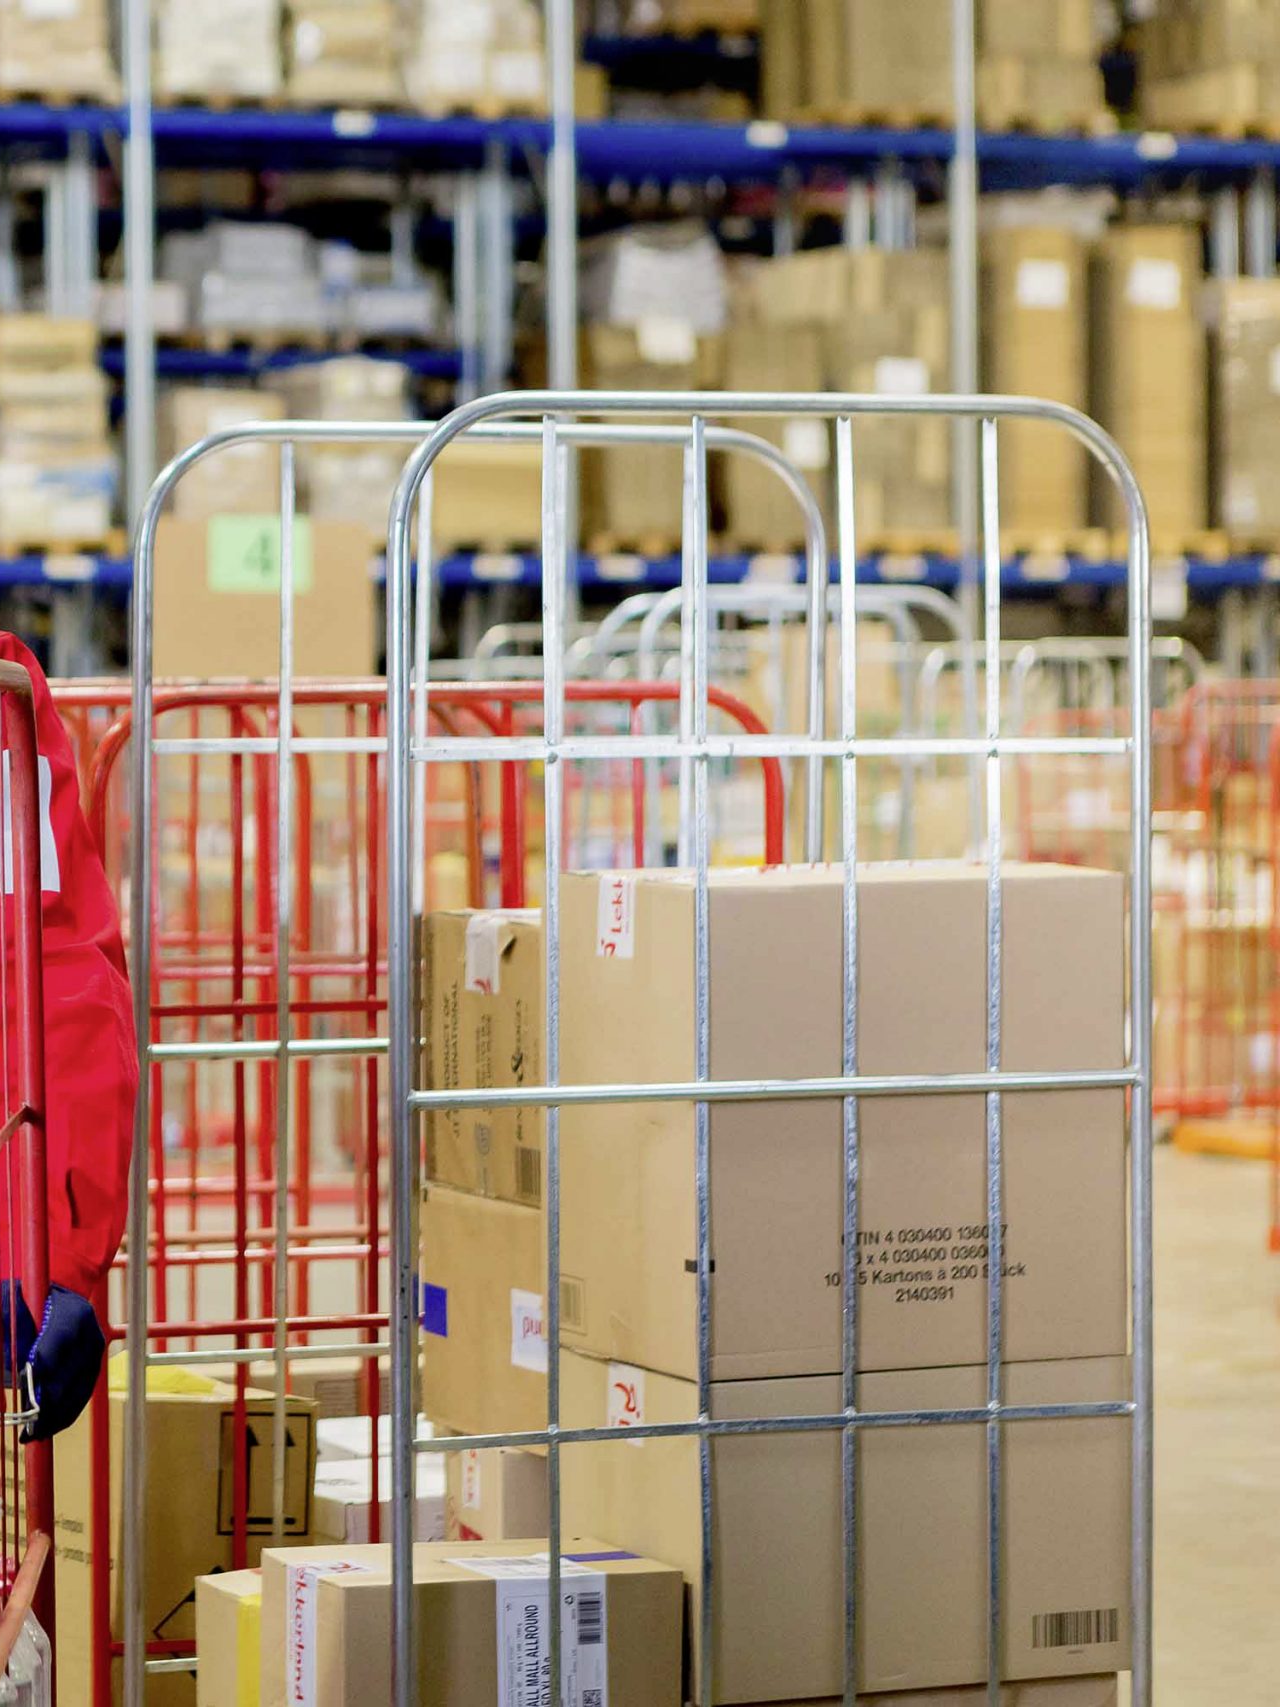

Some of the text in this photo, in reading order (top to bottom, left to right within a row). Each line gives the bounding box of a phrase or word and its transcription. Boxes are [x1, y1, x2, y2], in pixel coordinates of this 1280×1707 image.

[241, 526, 274, 582] 4
[884, 1229, 893, 1243] 4
[879, 1250, 888, 1264] 4
[824, 1272, 841, 1287] 10
[872, 1267, 934, 1286] Kartons
[951, 1265, 978, 1280] 200
[524, 1604, 539, 1659] ALLROUND
[525, 1661, 540, 1687] MALL
